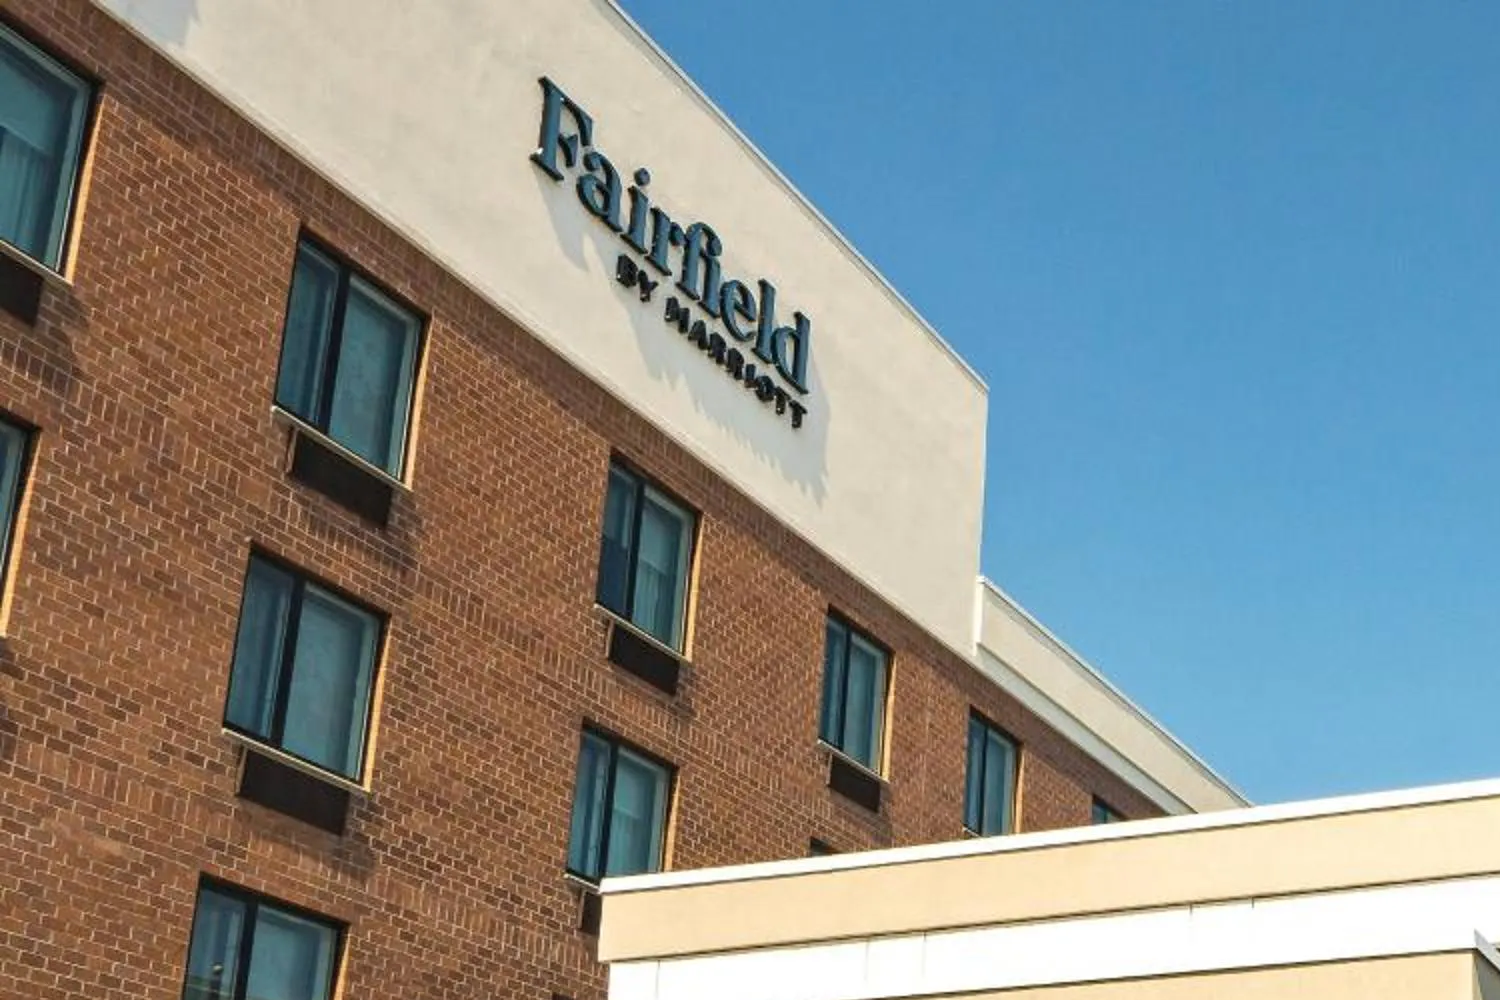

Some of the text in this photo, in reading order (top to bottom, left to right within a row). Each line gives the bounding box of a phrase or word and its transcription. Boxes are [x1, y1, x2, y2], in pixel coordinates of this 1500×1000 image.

[529, 75, 811, 396] Fairfield
[615, 254, 808, 429] BY MARRIOTT
